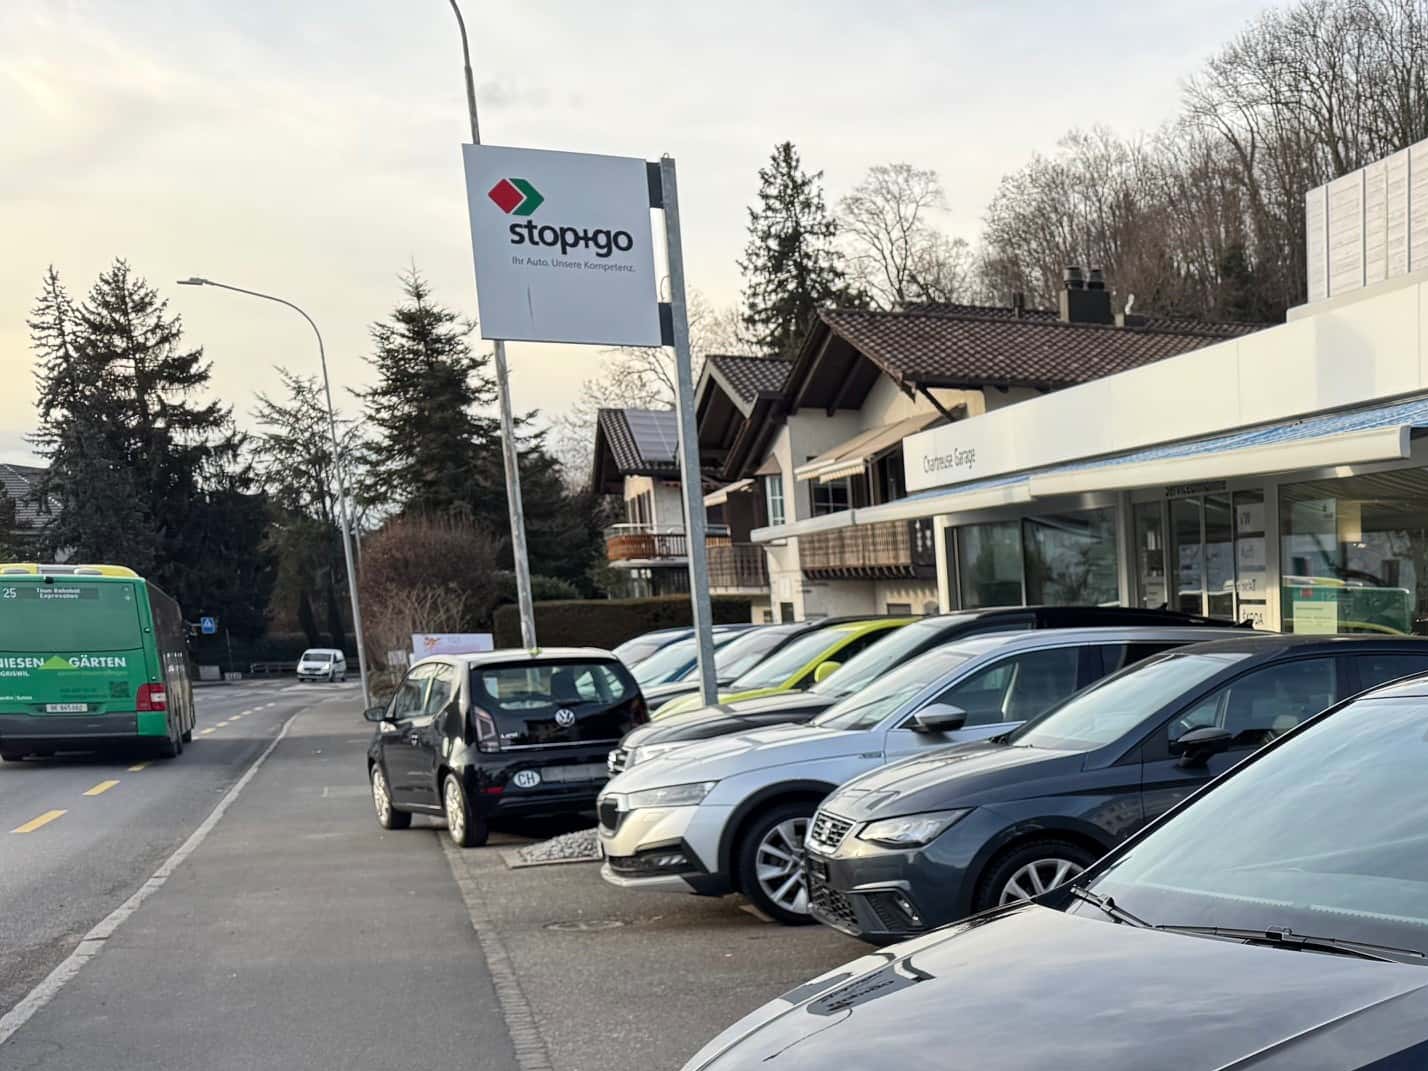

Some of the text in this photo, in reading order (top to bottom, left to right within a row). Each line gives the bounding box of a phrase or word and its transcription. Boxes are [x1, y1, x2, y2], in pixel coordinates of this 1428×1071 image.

[508, 219, 634, 258] stop+go
[512, 256, 524, 265] Ihr
[551, 259, 582, 270] Unsere
[584, 261, 636, 273] Kompetenz.
[3, 588, 17, 599] 25
[69, 655, 126, 668] GÄRTEN
[518, 773, 536, 785] CH
